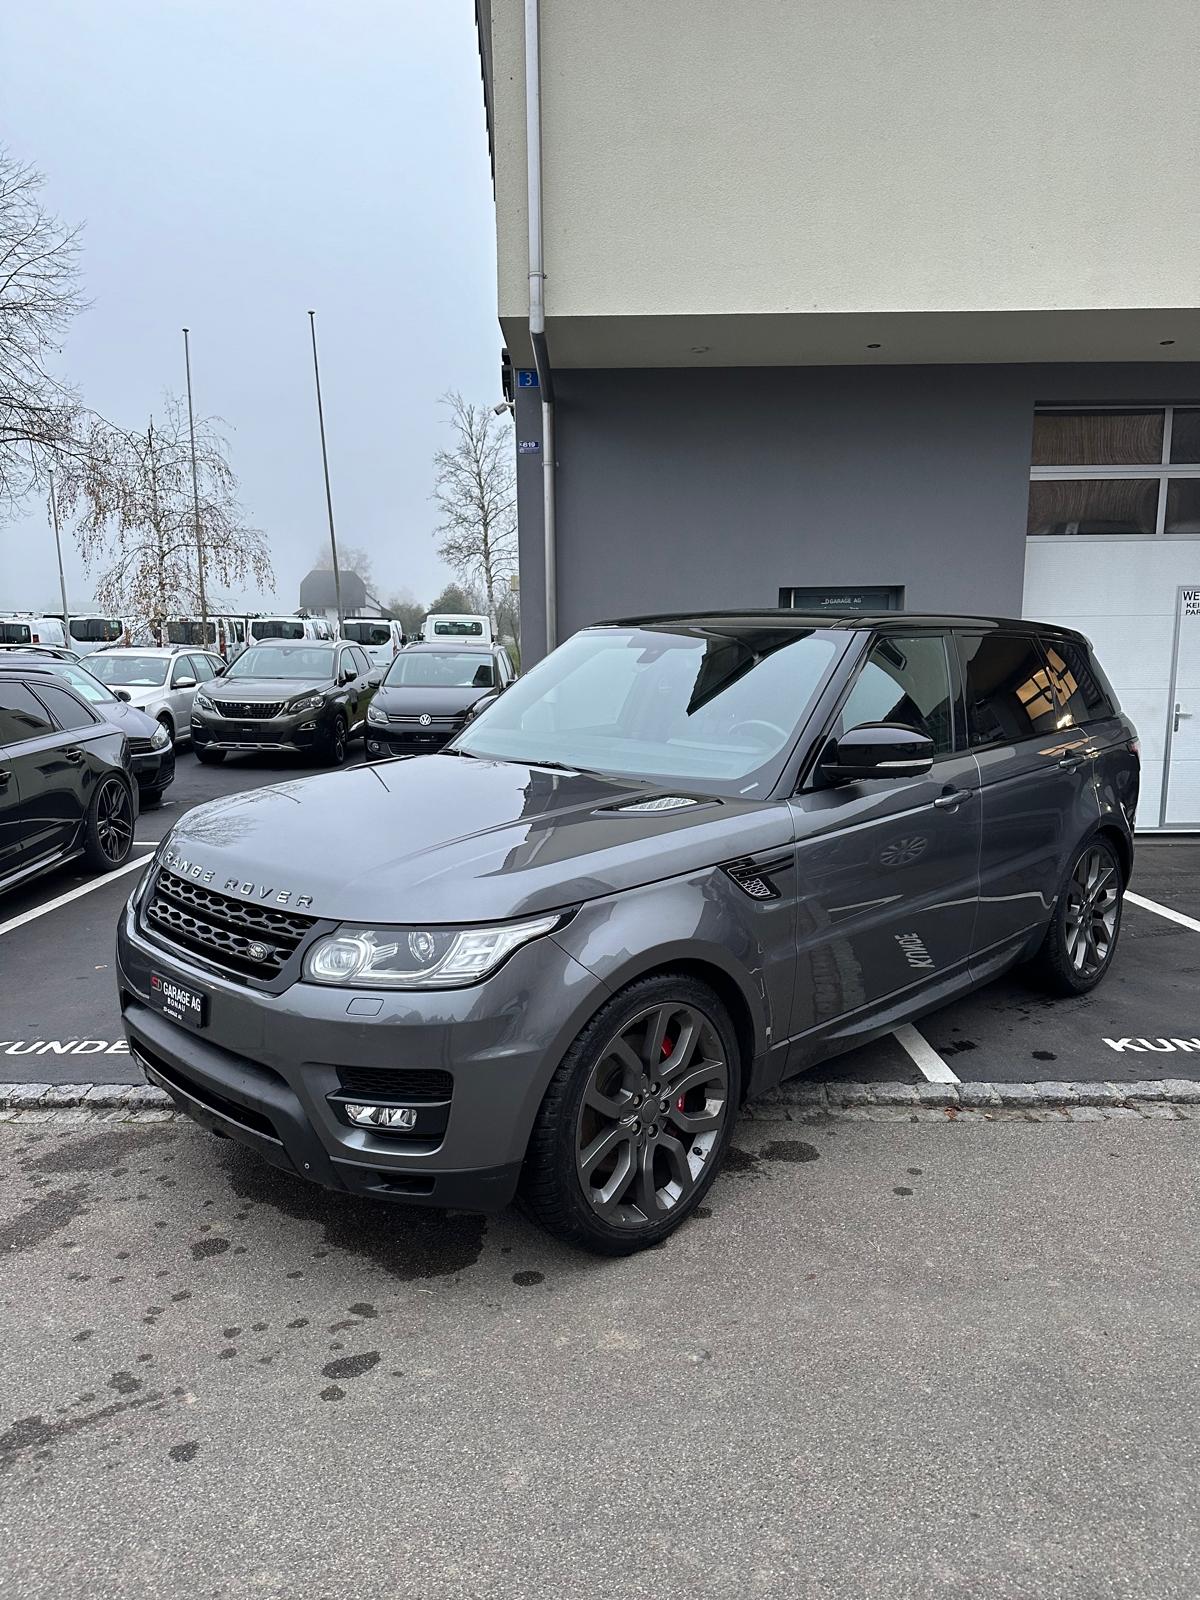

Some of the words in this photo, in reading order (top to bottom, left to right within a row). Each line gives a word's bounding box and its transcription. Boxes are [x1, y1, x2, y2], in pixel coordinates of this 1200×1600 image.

[525, 372, 532, 386] 3
[1183, 591, 1200, 601] WE
[164, 851, 215, 883] RANGE
[224, 878, 313, 908] ROVER
[163, 982, 190, 1007] GARAGE
[191, 995, 201, 1012] AG
[167, 997, 186, 1012] BONAU
[0, 1040, 130, 1055] UNDE
